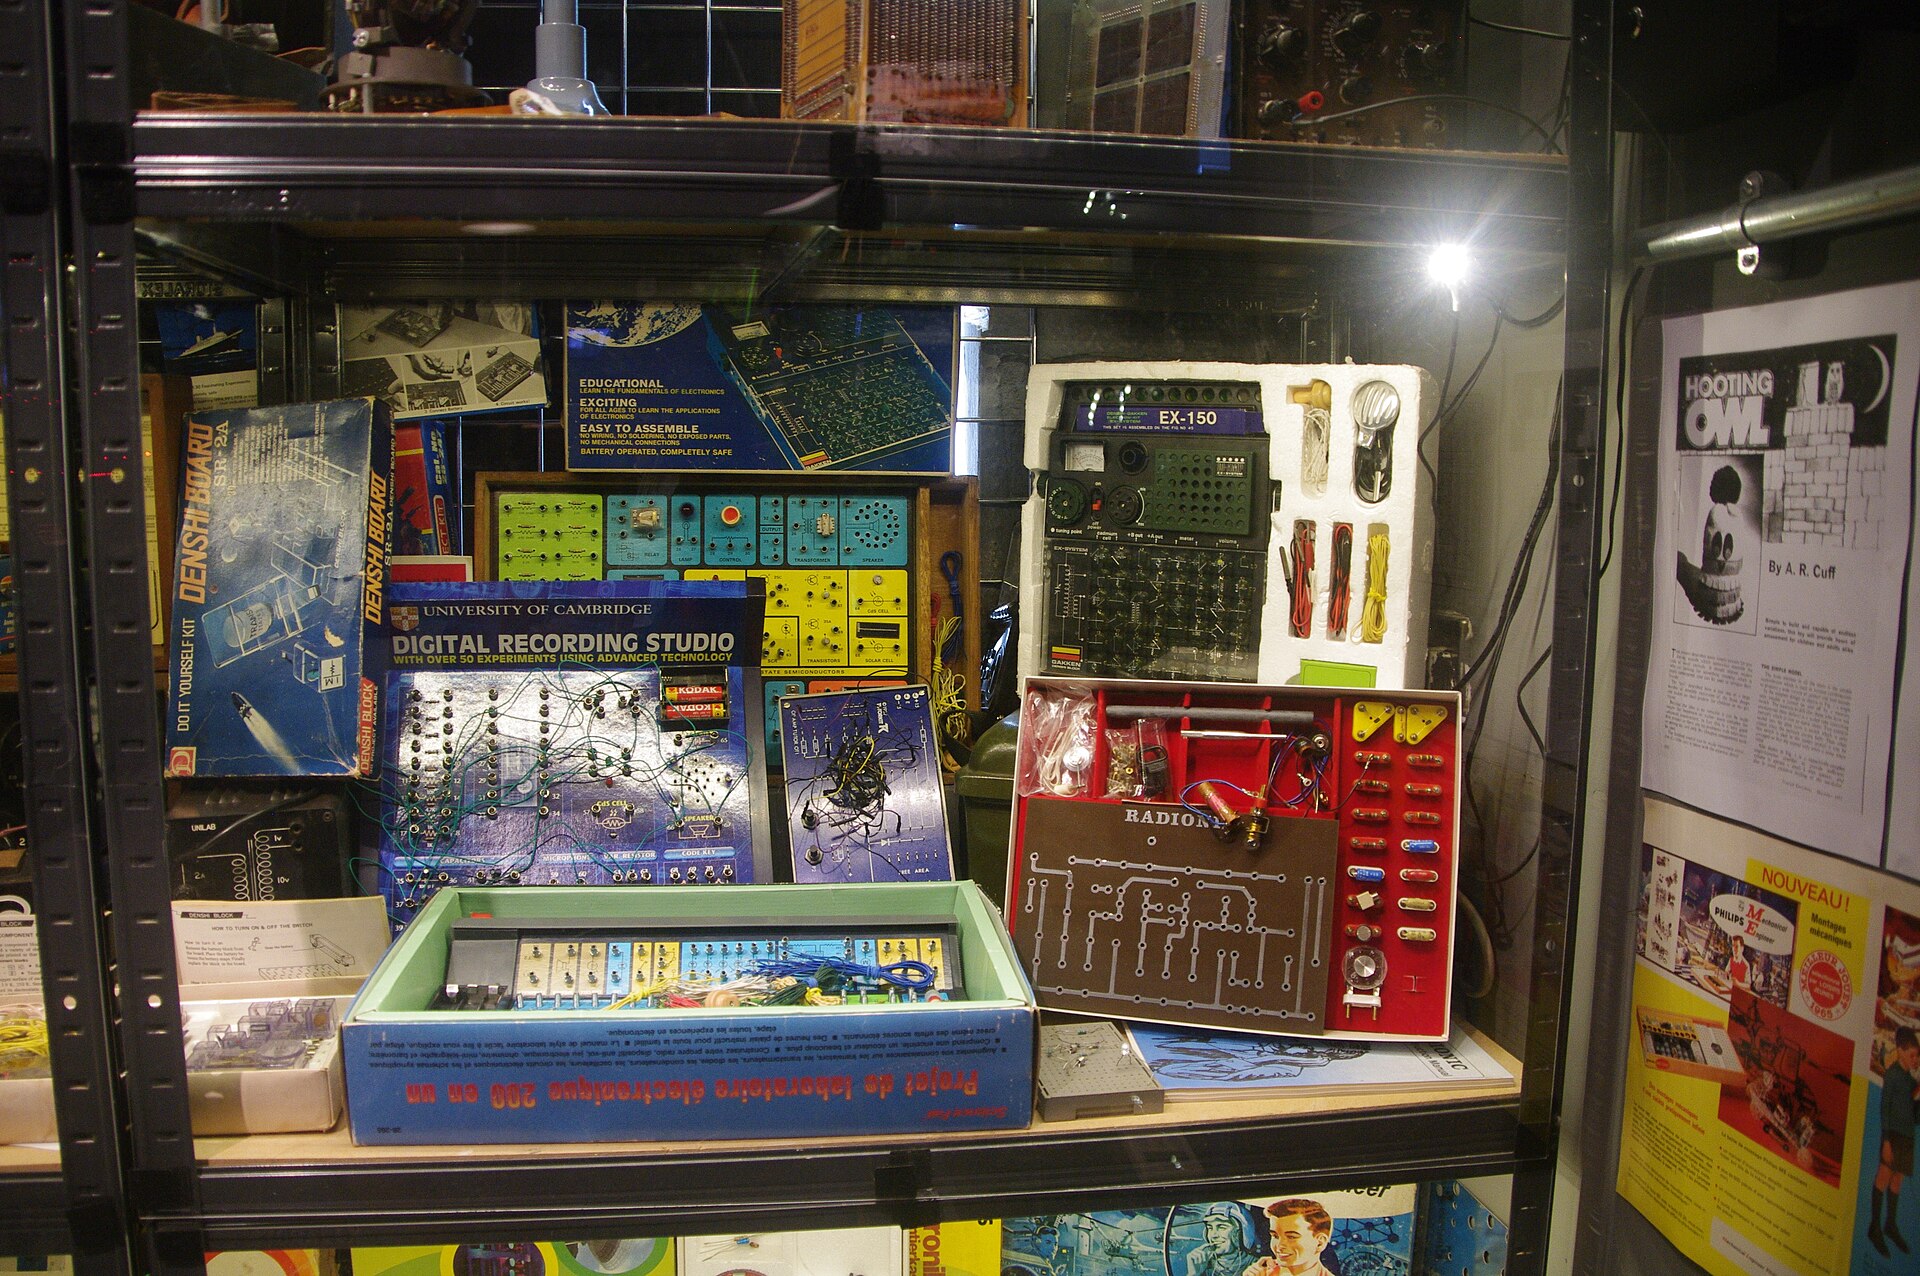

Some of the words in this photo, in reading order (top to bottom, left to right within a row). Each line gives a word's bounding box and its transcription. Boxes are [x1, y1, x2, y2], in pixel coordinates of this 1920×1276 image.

[579, 379, 664, 388] EDUCATIONAL
[1686, 370, 1774, 398] HOOTING
[579, 399, 637, 407] EXCITING
[580, 424, 611, 432] EASY
[615, 424, 631, 432] TO
[635, 425, 699, 433] ASSEMBLE
[1159, 410, 1218, 425] EX-150
[1685, 396, 1771, 448] OWL
[184, 420, 213, 505] BOARD
[213, 420, 229, 487] SR-2A
[368, 466, 386, 544] BOARD
[437, 503, 445, 525] KIT
[385, 510, 394, 566] SR-2A
[179, 508, 210, 604] DENSHI
[1769, 560, 1781, 576] By
[1785, 563, 1795, 575] A.
[1799, 563, 1809, 577] R.
[1813, 565, 1837, 580] Cuff
[365, 542, 384, 625] DENSHI
[423, 605, 522, 617] UNIVERSITY
[528, 605, 549, 615] OF
[554, 604, 653, 615] CAMBRIDGE
[181, 617, 195, 637] KIT
[392, 634, 490, 655] DIGITAL
[498, 633, 639, 654] RECORDING
[649, 632, 735, 652] STUDIO
[178, 640, 194, 697] YOURSELF
[393, 655, 424, 665] WITH
[427, 655, 457, 665] OVER
[460, 654, 474, 664] 50
[477, 654, 556, 664] EXPERIMENTS
[559, 653, 595, 664] USING
[597, 653, 658, 663] ADVANCED
[661, 653, 733, 663] TECHNOLOGY
[678, 686, 717, 694] KODAK
[178, 701, 190, 712] IT
[362, 682, 373, 722] BLOCK
[177, 716, 190, 731] DO
[361, 726, 371, 770] DENSHI
[191, 824, 216, 832] UNILAB
[19, 838, 26, 846] 2
[1715, 907, 1744, 926] PHILIPS
[1746, 903, 1788, 933] Mechanical
[1811, 913, 1846, 934] Montages
[1744, 921, 1775, 945] Engineer
[1810, 927, 1852, 949] mécaniques
[1838, 968, 1850, 1009] JOUET
[1810, 1003, 1833, 1019] 1965
[606, 1028, 655, 1036] électronique.
[669, 1027, 714, 1035] expériences
[548, 1075, 706, 1108] électronique
[715, 1075, 853, 1104] laboratoire
[863, 1073, 894, 1101] de
[904, 1065, 979, 1098] Projet
[406, 1082, 436, 1104] un
[447, 1082, 479, 1104] en
[490, 1082, 537, 1111] 200
